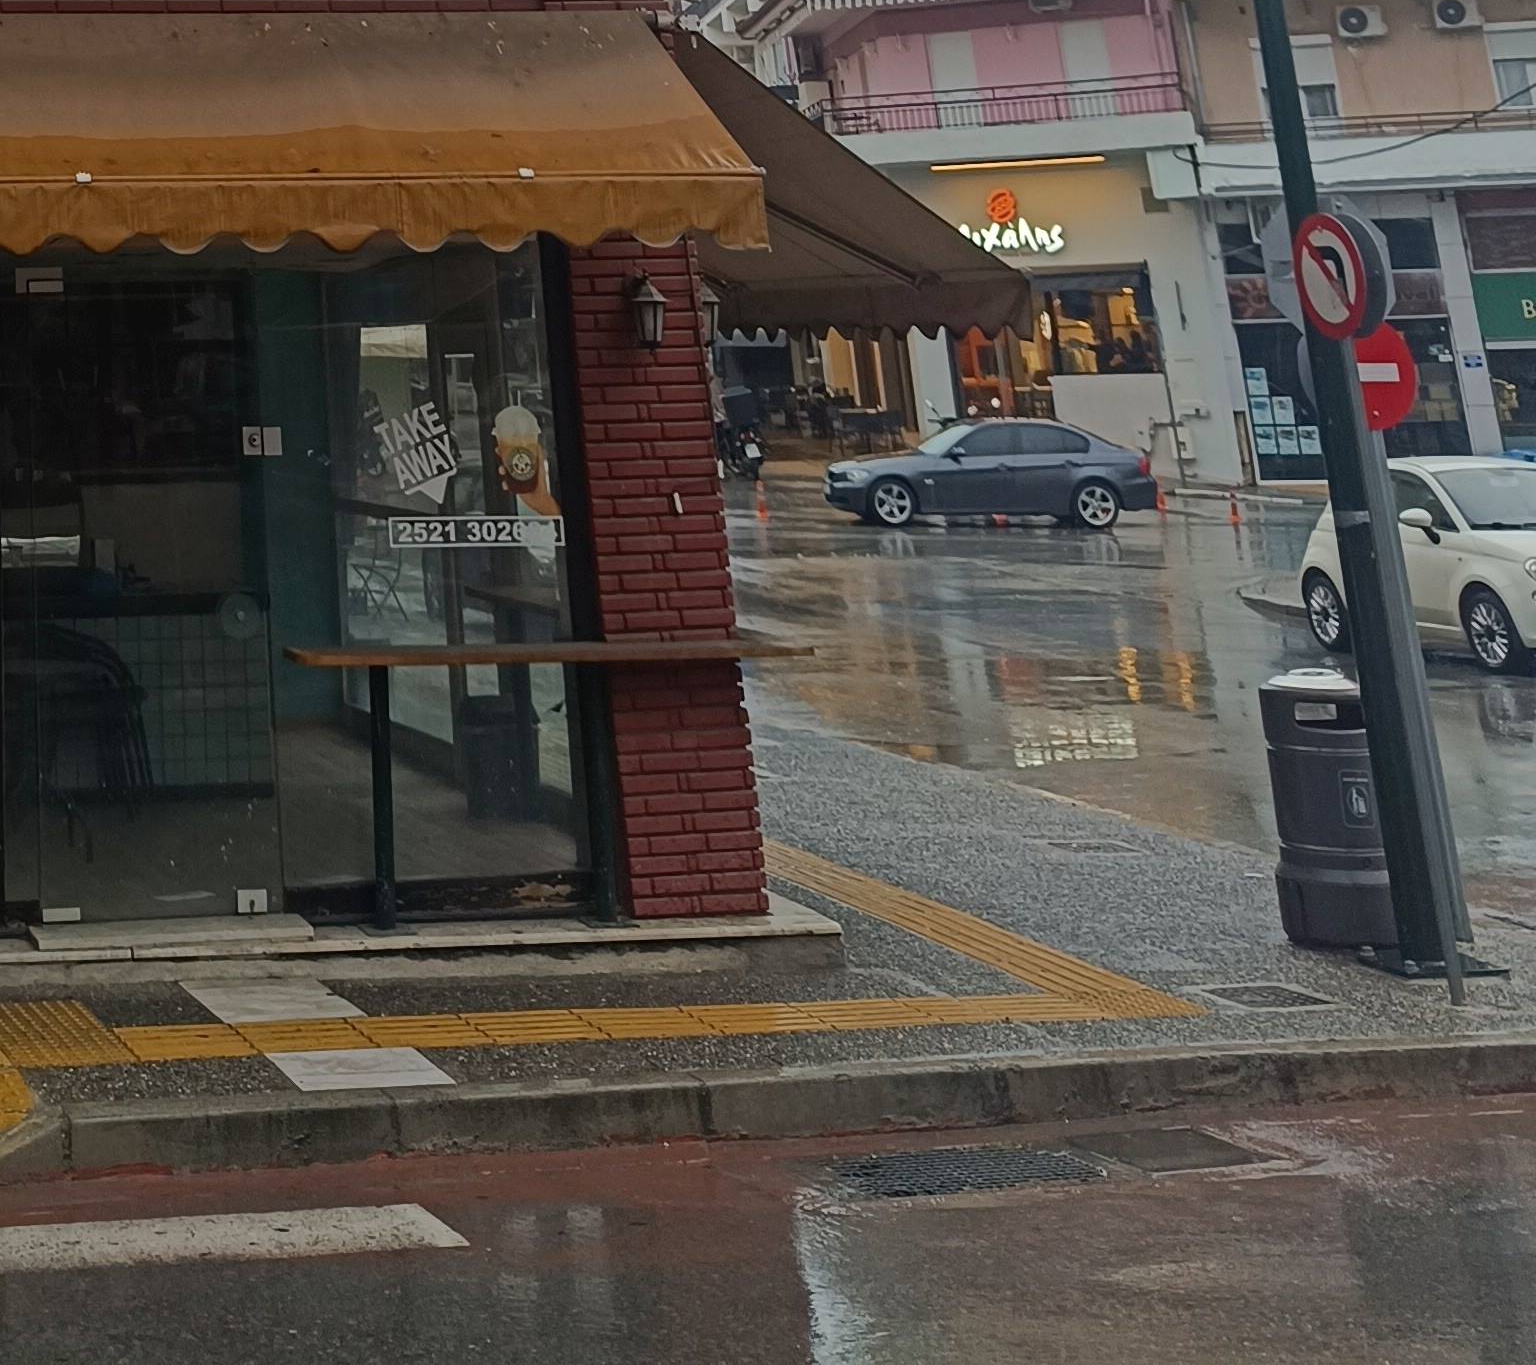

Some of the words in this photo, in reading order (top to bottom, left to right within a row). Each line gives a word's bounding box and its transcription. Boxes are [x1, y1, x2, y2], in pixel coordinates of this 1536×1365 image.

[372, 401, 447, 454] TAKE
[392, 434, 457, 489] AWAY
[398, 521, 456, 542] 2521
